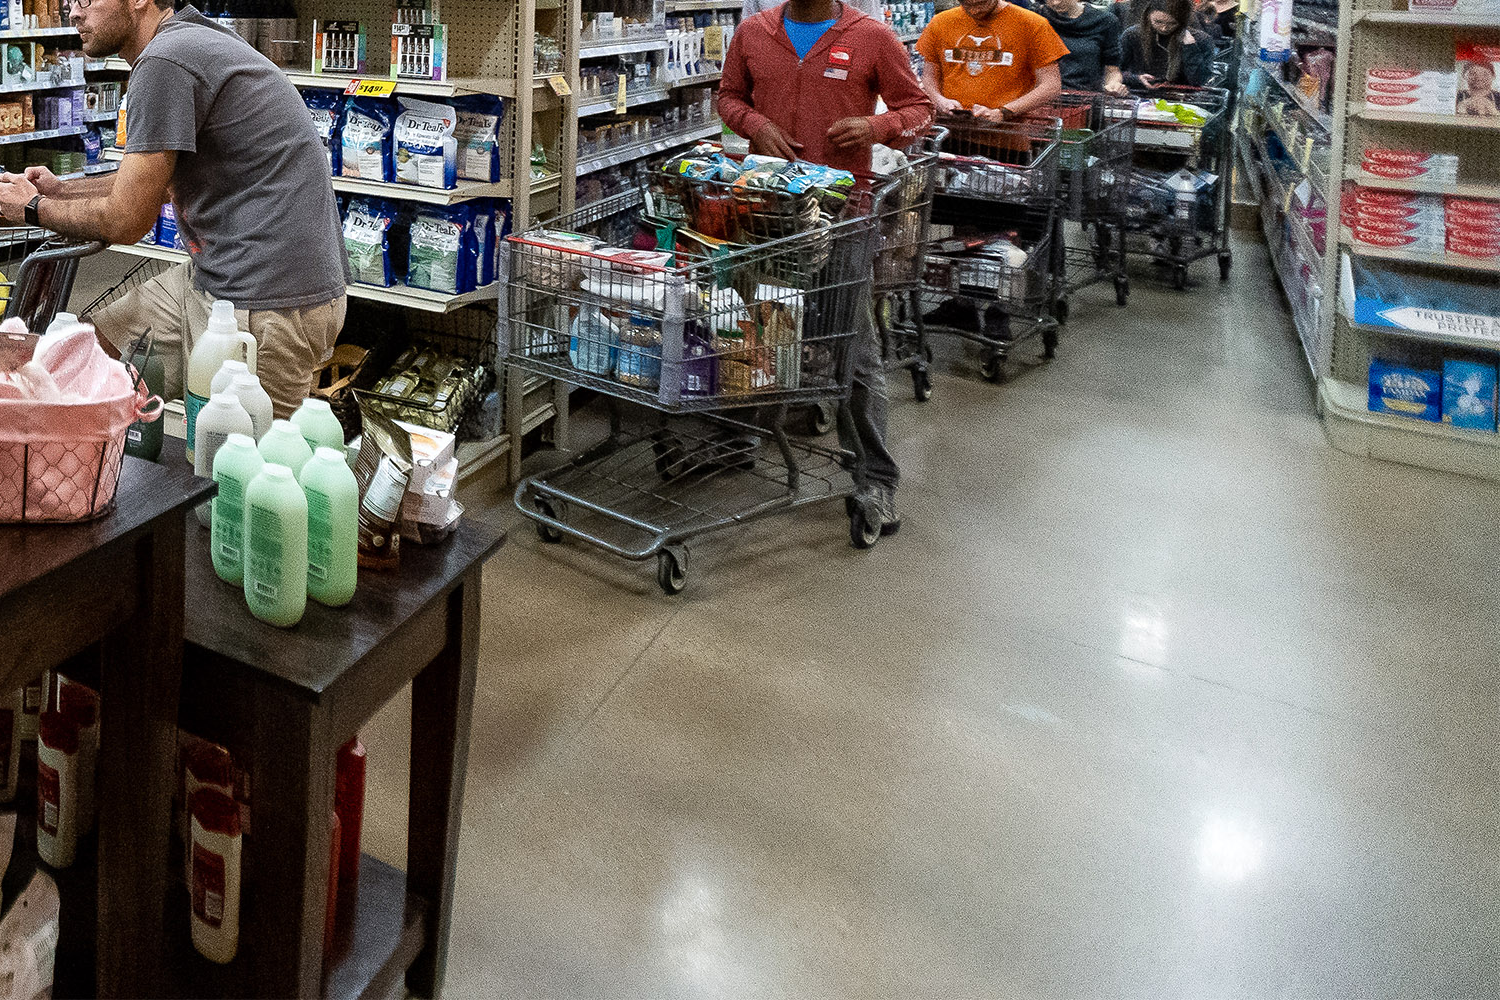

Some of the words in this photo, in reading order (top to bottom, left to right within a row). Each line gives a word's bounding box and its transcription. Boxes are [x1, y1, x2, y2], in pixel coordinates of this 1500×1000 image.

[409, 120, 421, 129] Dr
[1371, 151, 1419, 162] Colgate
[1369, 164, 1416, 175] Colgate
[354, 217, 365, 227] Dr
[1358, 232, 1406, 243] Colgate
[1415, 310, 1485, 328] TRUSTED
